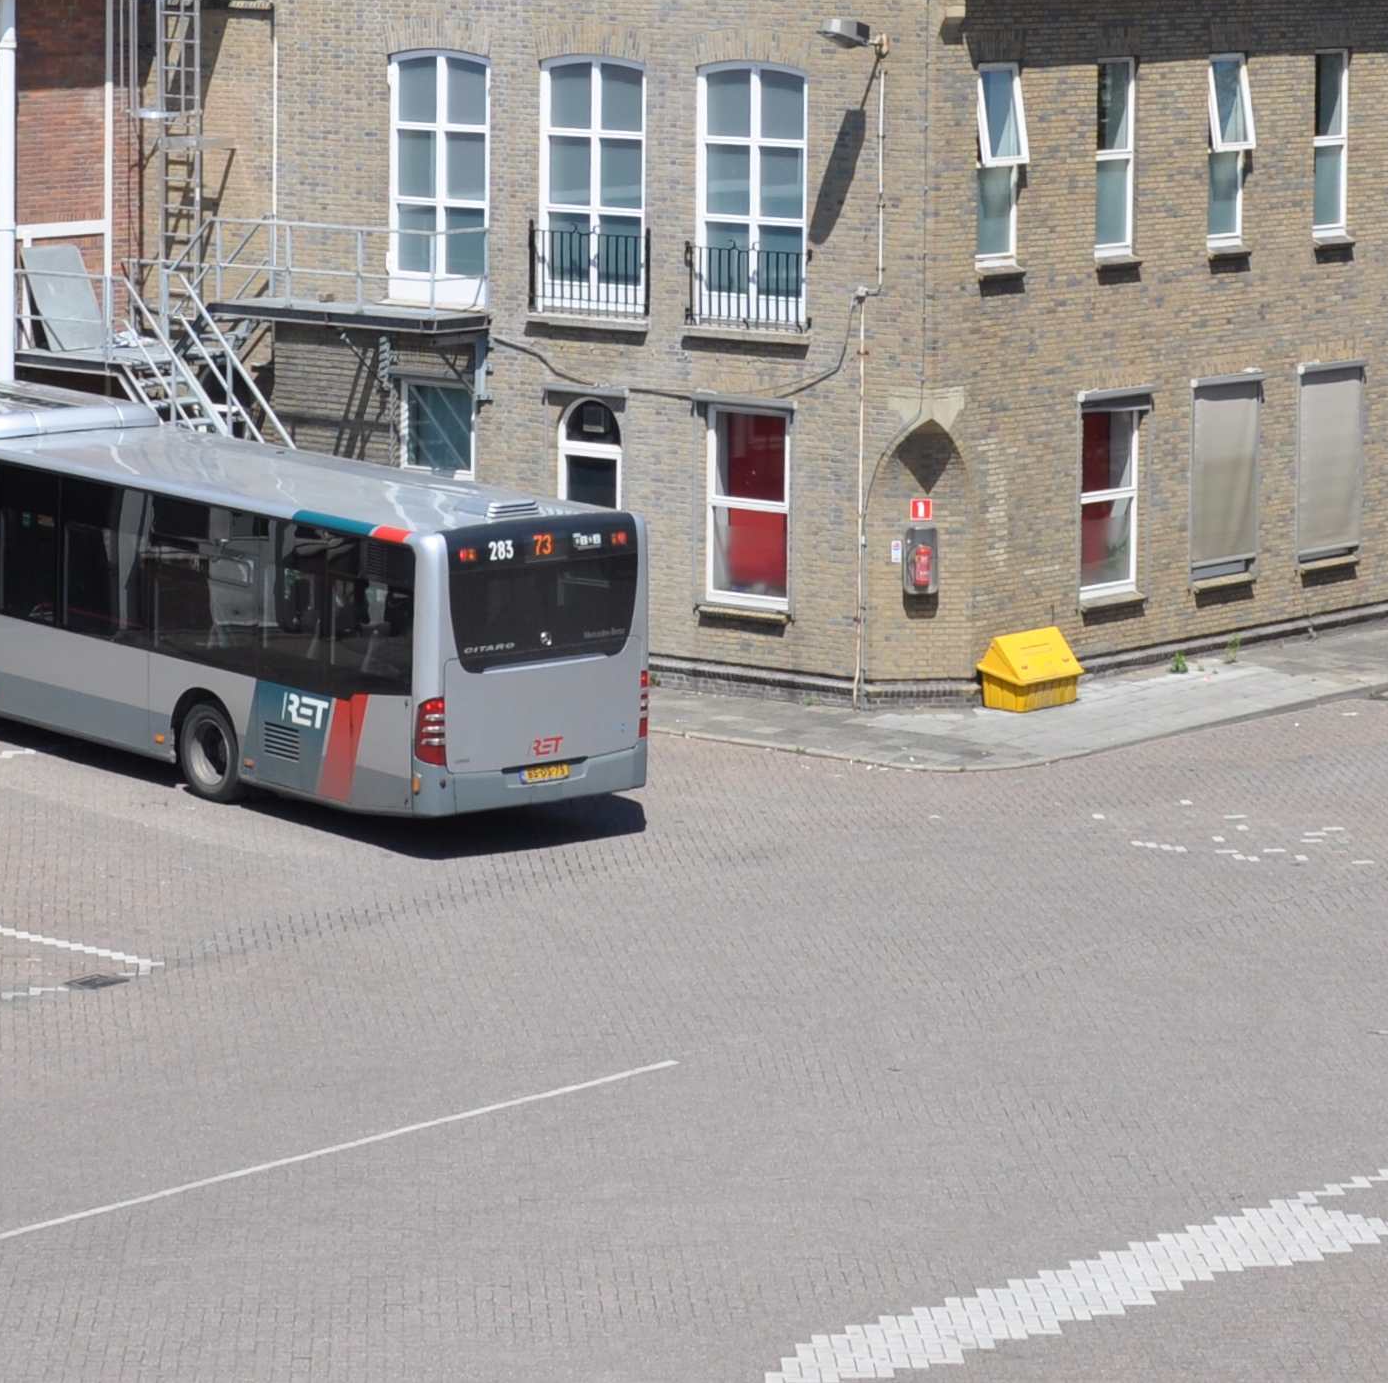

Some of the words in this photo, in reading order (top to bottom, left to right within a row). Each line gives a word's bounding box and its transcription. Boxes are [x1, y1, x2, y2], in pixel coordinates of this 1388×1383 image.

[488, 540, 514, 561] 283
[533, 533, 555, 556] 73
[464, 642, 515, 654] CITARO
[281, 691, 329, 729] RET
[527, 736, 564, 756] RET
